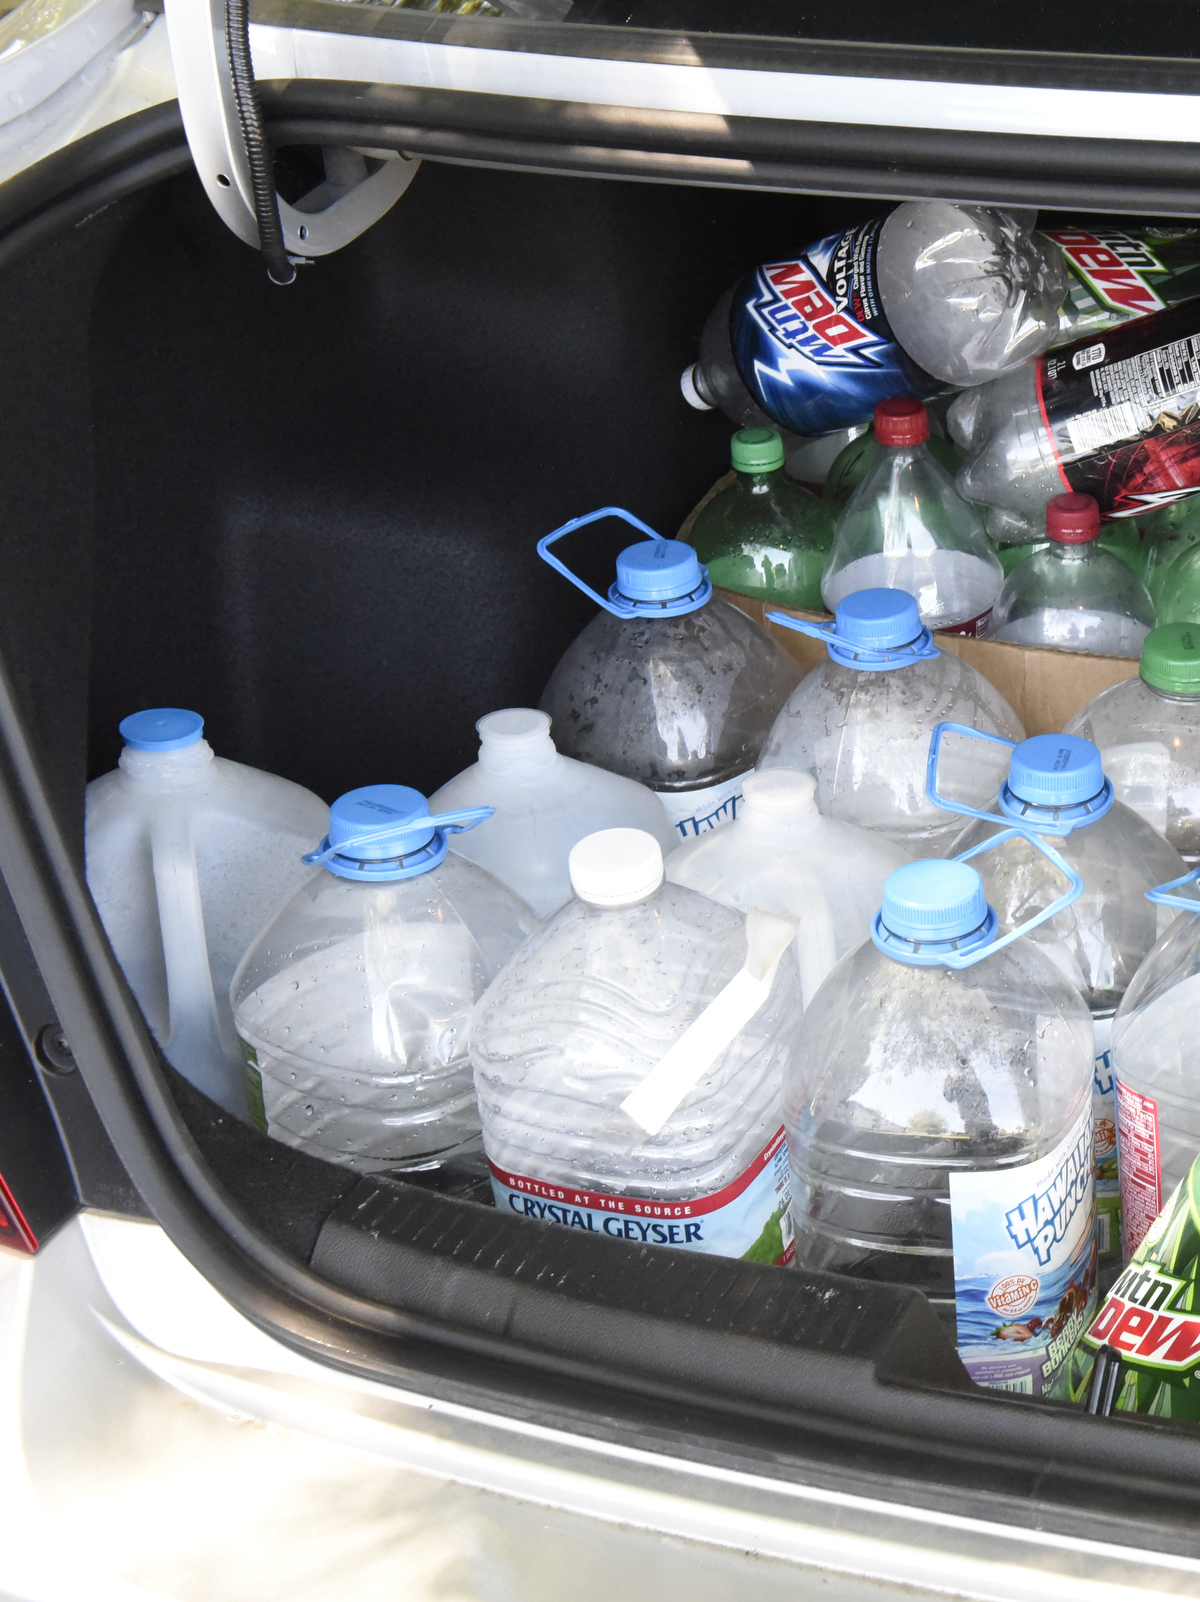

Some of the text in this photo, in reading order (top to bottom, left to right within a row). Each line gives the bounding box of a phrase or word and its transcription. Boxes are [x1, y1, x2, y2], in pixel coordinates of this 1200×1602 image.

[834, 226, 859, 313] VOLTAGE
[863, 298, 872, 319] Citrus
[1036, 1169, 1054, 1188] Made
[1055, 1152, 1067, 1168] With
[509, 1177, 692, 1216] BOTTLED AT THE SOURCE
[509, 1193, 704, 1244] CRYSTAL GEYSER
[999, 1279, 1016, 1292] 100%
[1030, 1279, 1038, 1292] C
[1111, 1269, 1172, 1311] Mtn
[1042, 1313, 1085, 1378] BONKERS
[1048, 1308, 1077, 1357] BERRY
